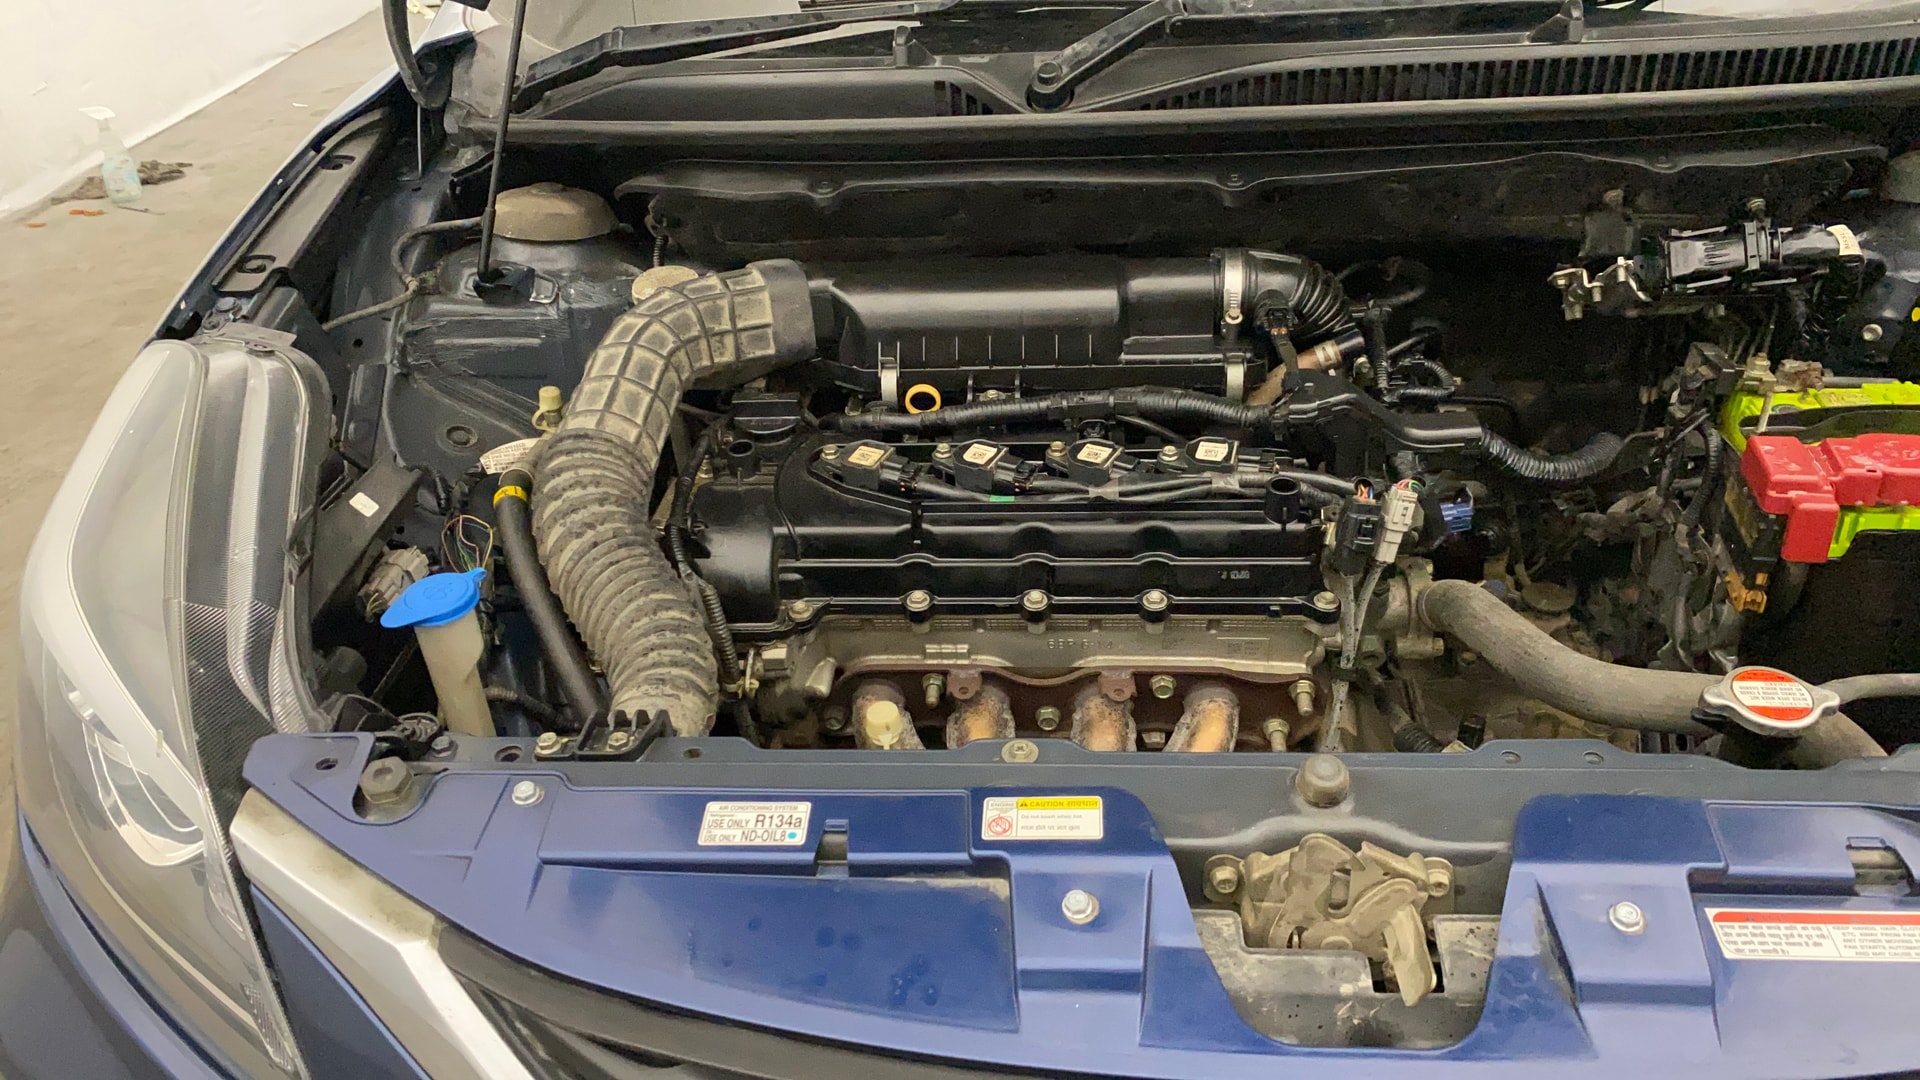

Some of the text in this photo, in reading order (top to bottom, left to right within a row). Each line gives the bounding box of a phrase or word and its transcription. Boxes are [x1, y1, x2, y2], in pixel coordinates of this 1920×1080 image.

[707, 814, 802, 828] USE ONLY R134a
[704, 830, 786, 842] USE ONLY ND-OIL8
